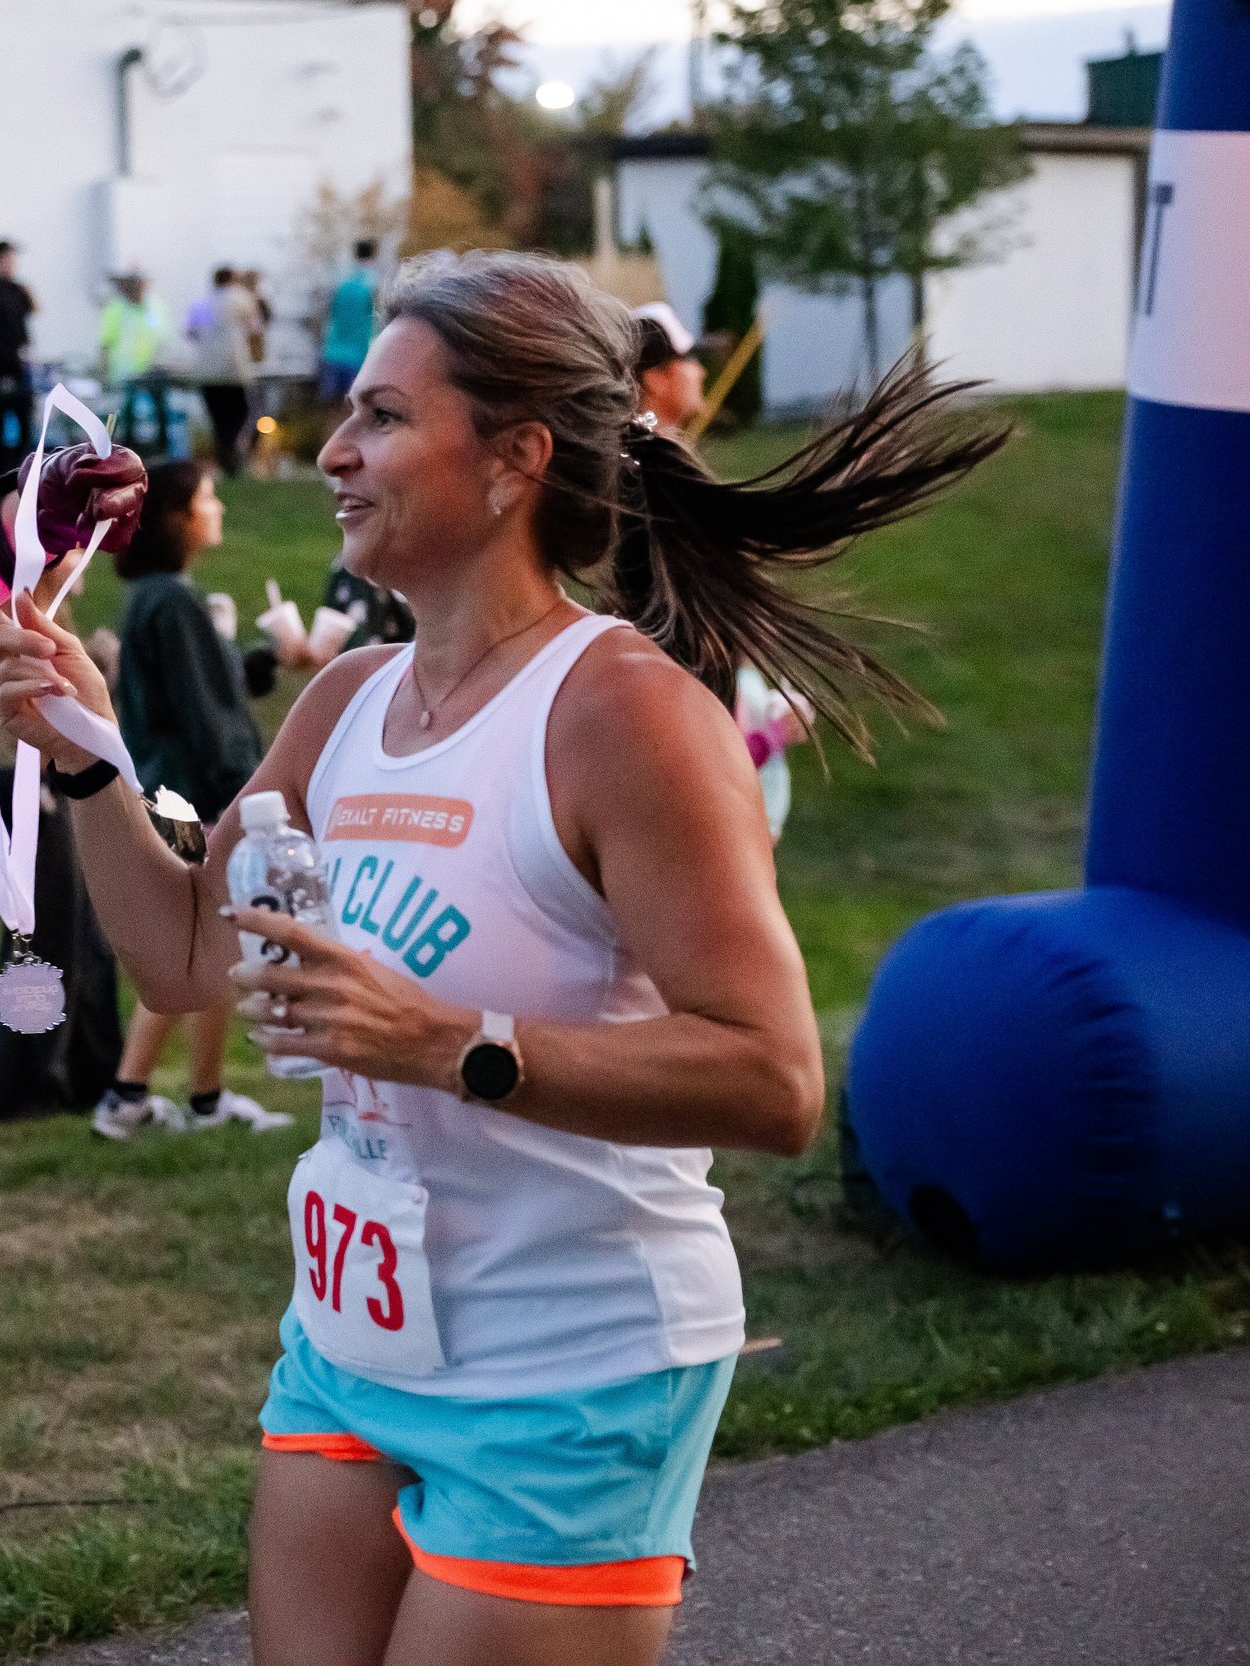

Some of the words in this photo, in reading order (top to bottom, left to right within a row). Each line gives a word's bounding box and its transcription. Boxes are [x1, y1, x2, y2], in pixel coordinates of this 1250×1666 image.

[381, 806, 464, 833] FITNESS
[341, 855, 471, 978] CLUB
[304, 1190, 404, 1331] 973
